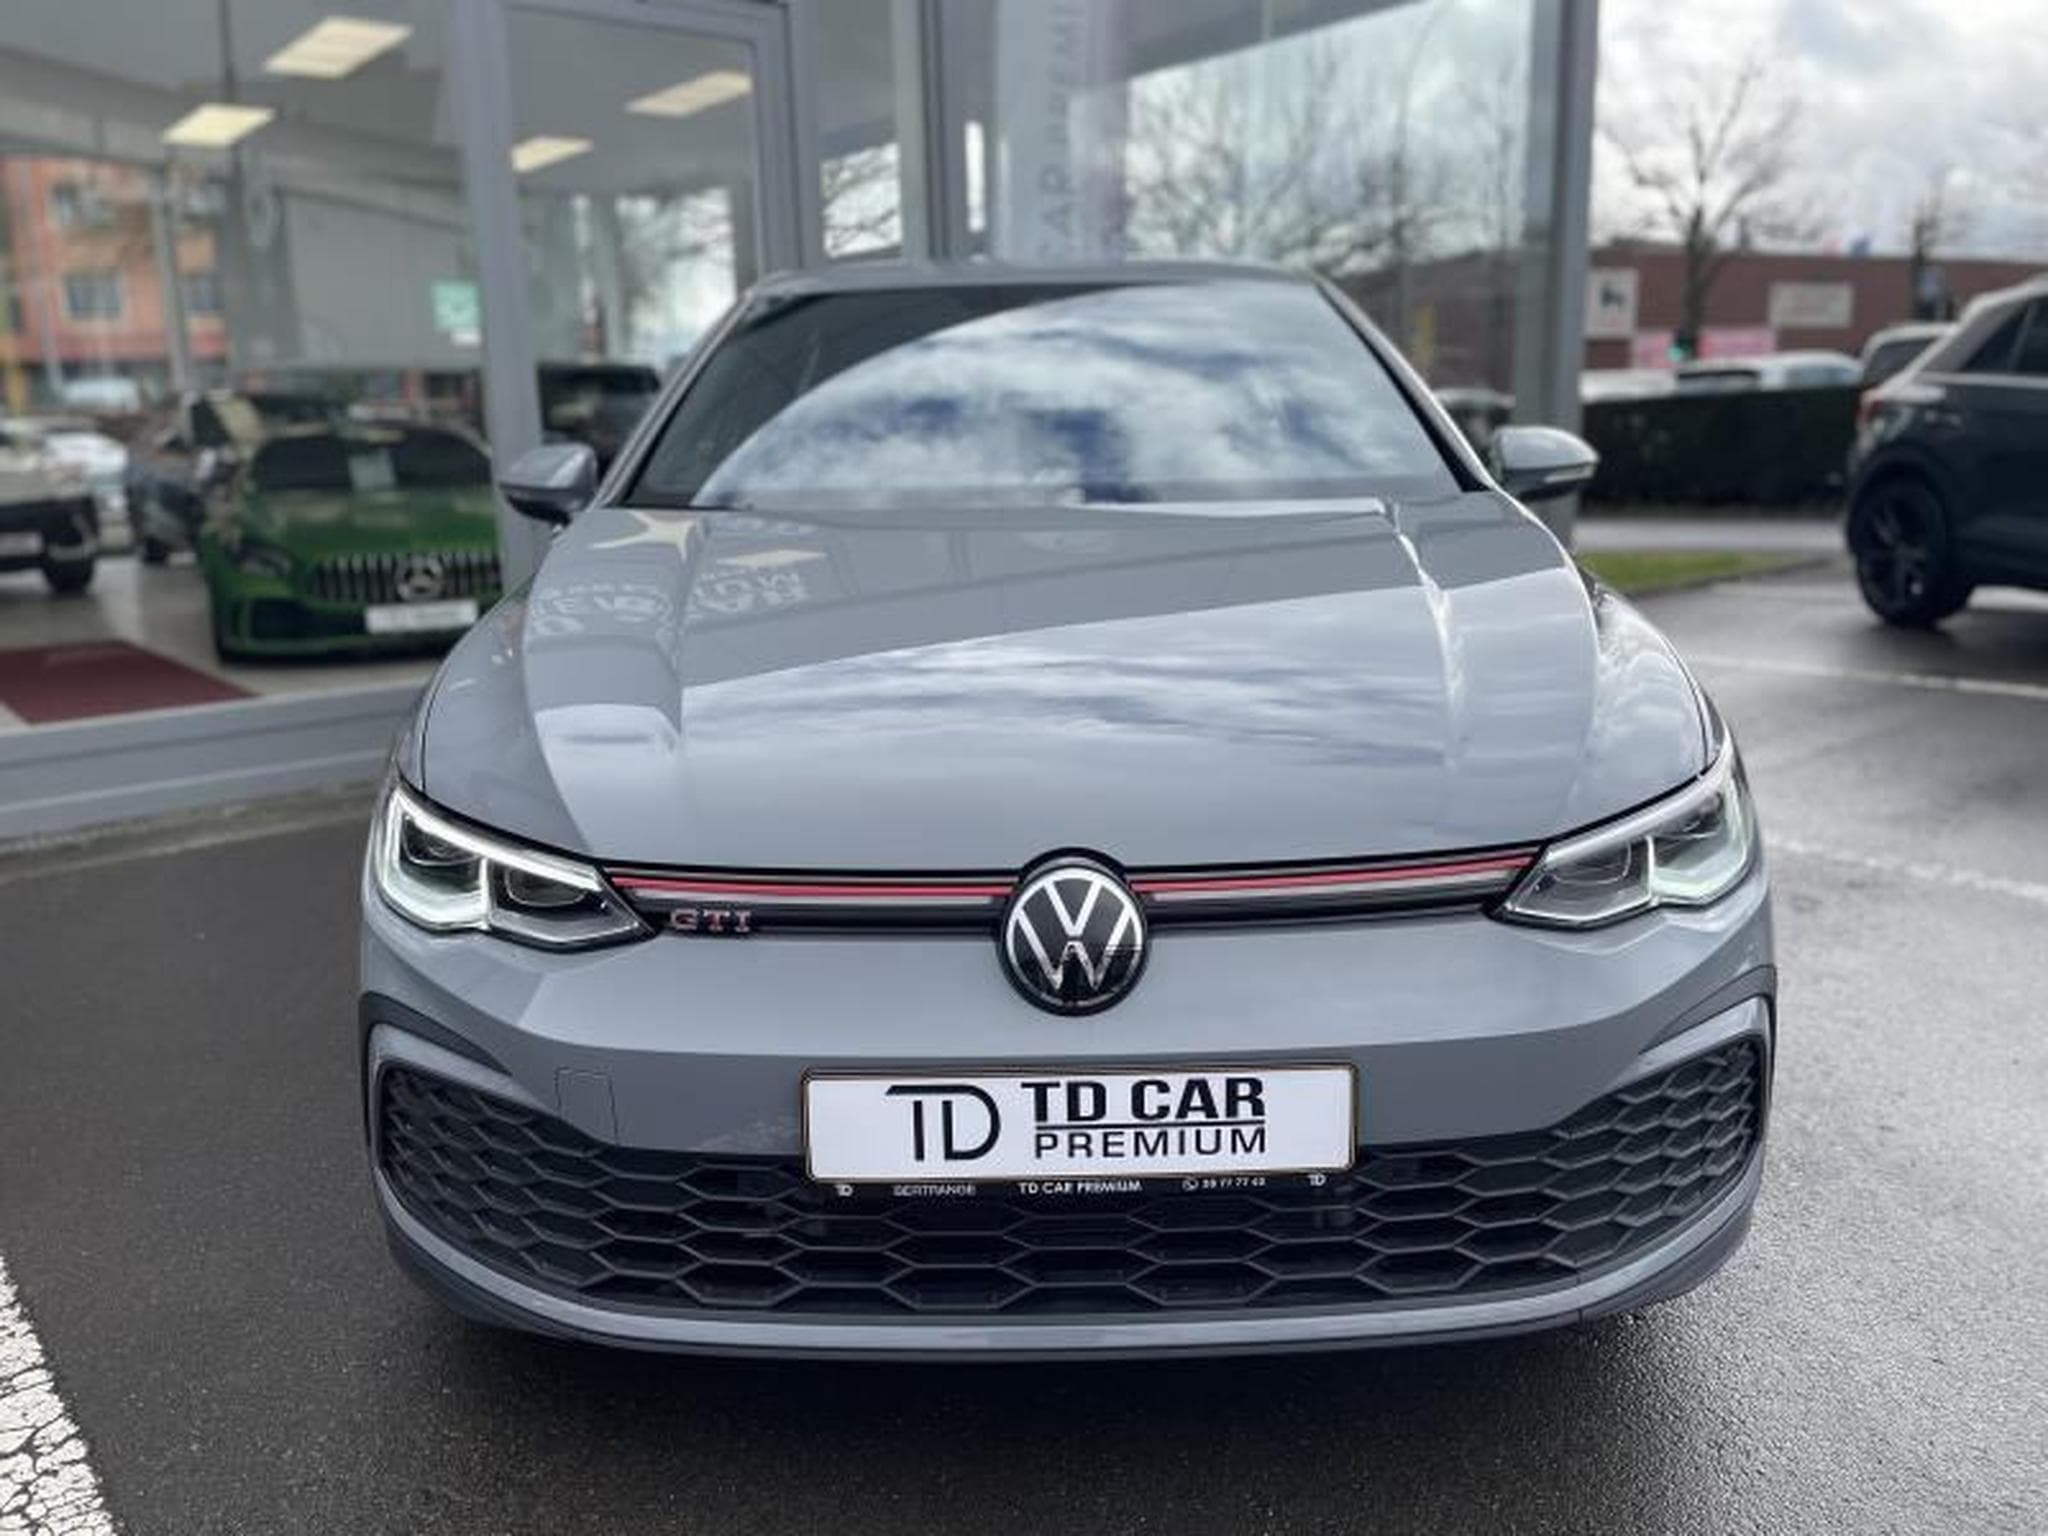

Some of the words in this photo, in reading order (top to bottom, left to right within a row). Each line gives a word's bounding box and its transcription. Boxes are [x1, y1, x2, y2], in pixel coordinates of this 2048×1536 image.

[670, 908, 751, 933] GTI
[1021, 1081, 1107, 1122] TD
[1131, 1076, 1266, 1120] CAR
[886, 1084, 1001, 1161] TD
[1034, 1127, 1266, 1158] PREMIUM
[1019, 1182, 1039, 1195] TD
[1042, 1181, 1073, 1195] CAR
[1077, 1179, 1142, 1194] PREMIUM
